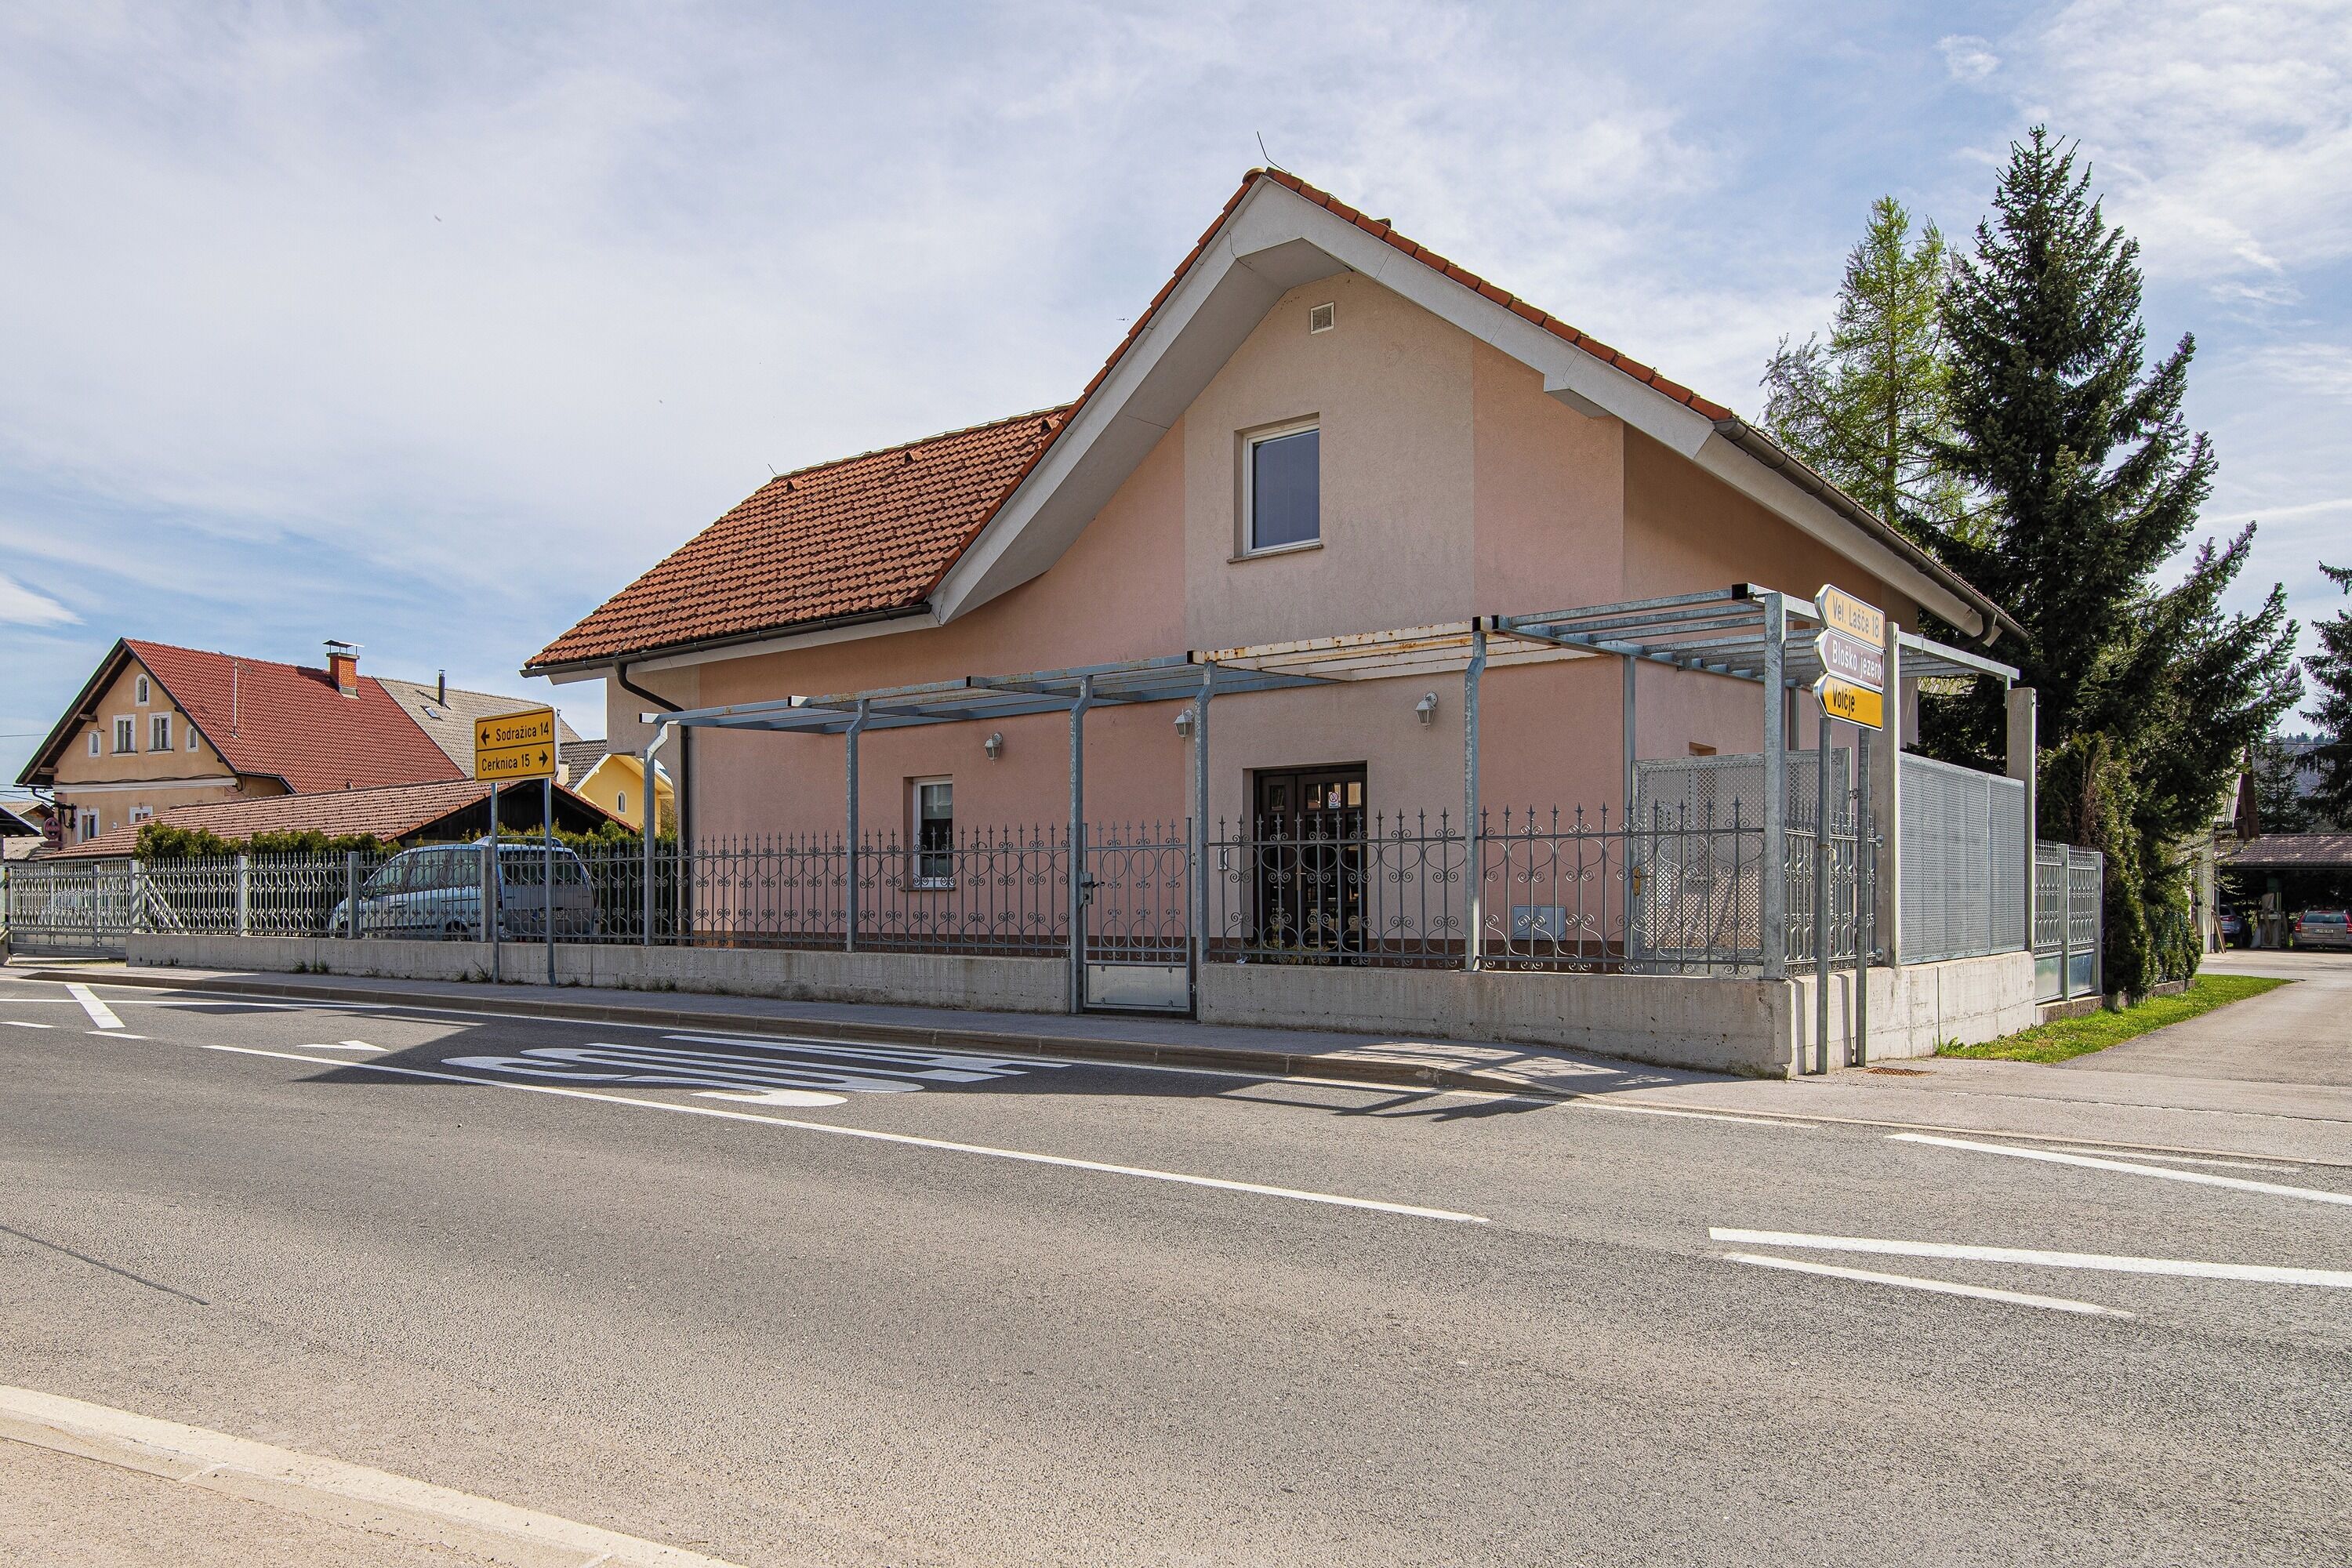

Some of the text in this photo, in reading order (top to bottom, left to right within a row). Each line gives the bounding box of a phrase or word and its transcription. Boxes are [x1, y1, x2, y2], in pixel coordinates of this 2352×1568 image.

[1832, 595, 1879, 638] Vel. Lašče 18
[1832, 639, 1882, 680] Bloško jezero
[1832, 684, 1855, 717] Volčje
[495, 721, 550, 742] Sodražica 14
[481, 753, 530, 771] Cerknica 15
